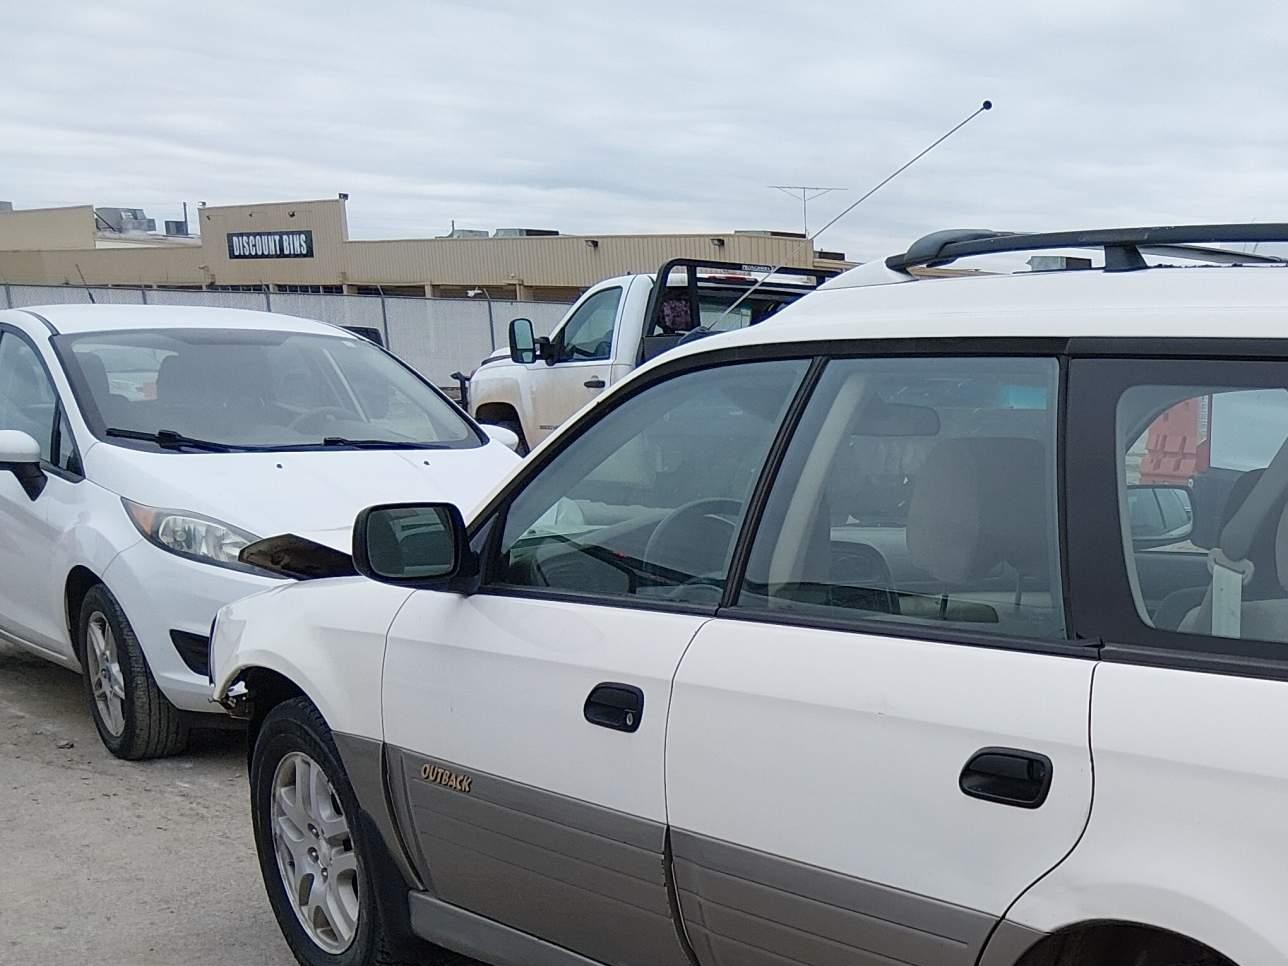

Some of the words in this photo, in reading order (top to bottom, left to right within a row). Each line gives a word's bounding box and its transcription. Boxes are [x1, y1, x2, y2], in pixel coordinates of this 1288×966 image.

[232, 235, 280, 256] DISCOUNT
[282, 233, 307, 255] BINS
[421, 763, 473, 793] OUTBACK
